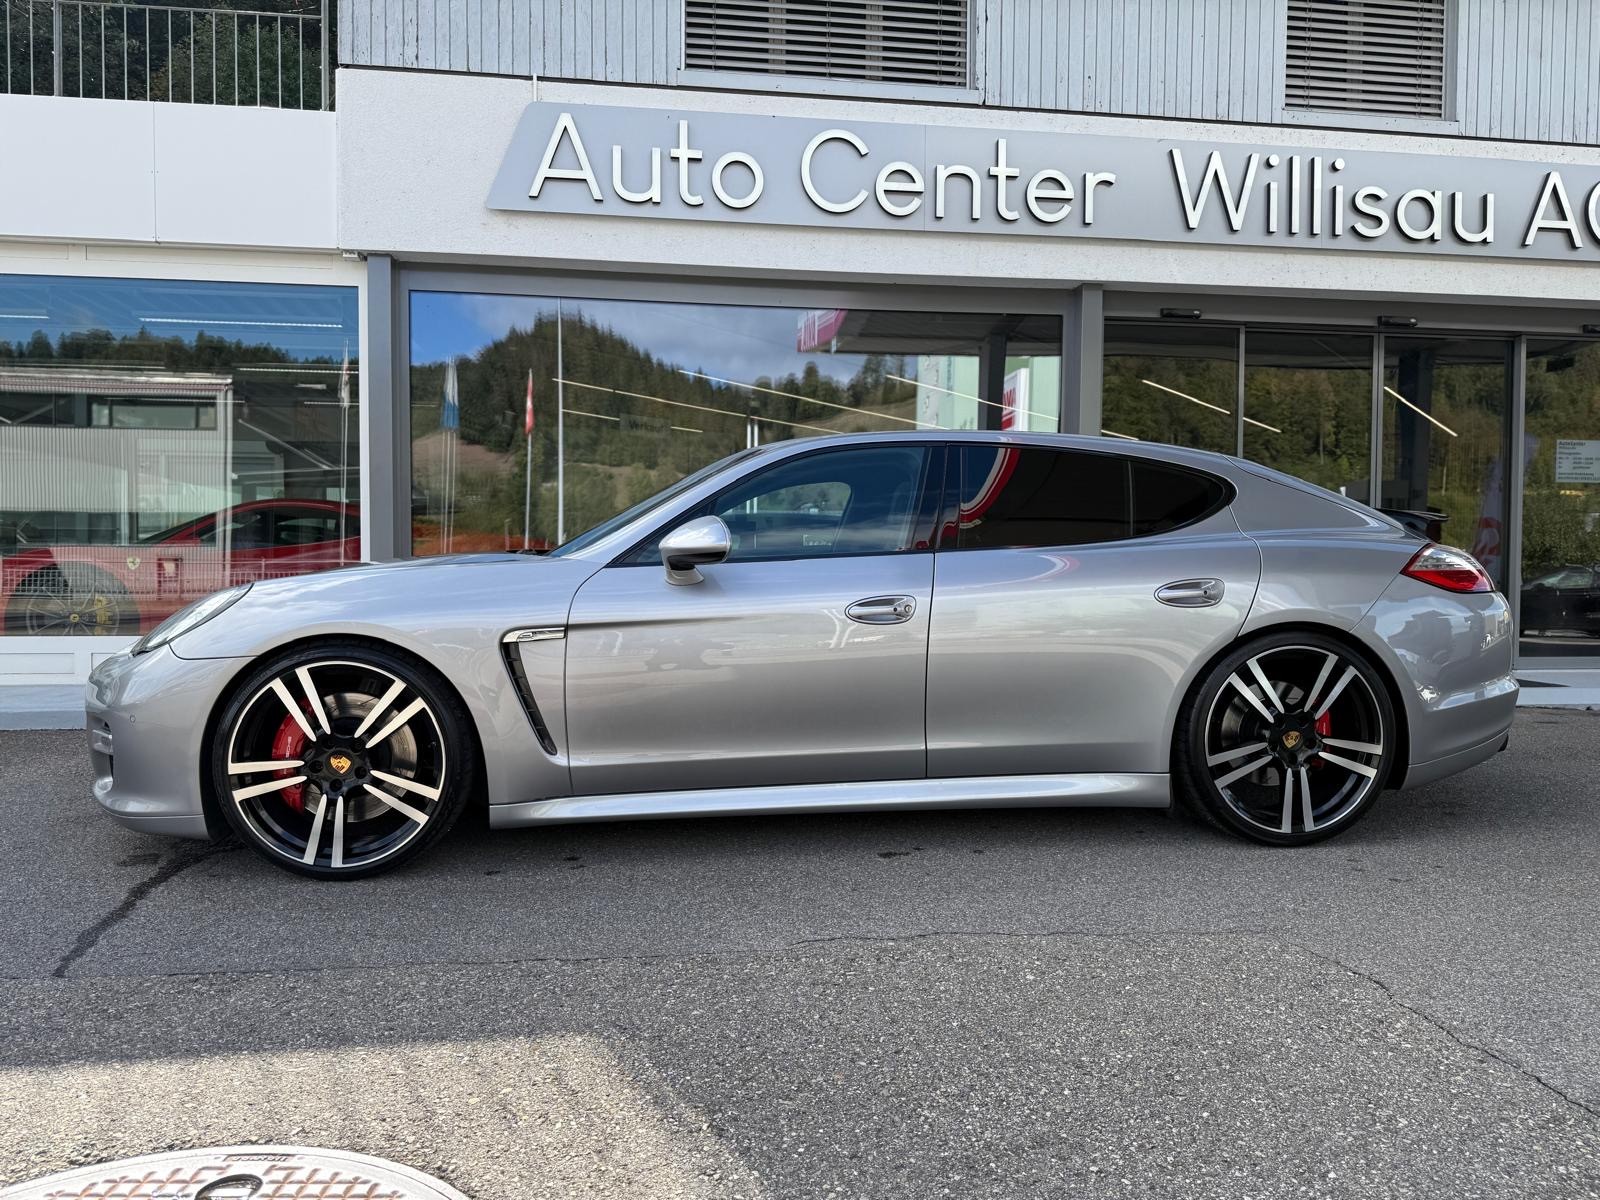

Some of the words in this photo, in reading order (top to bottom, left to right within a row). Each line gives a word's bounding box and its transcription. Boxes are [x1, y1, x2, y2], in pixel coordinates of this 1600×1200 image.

[528, 112, 764, 209] Auto
[800, 128, 1117, 225] Center
[1168, 148, 1495, 244] Willisau
